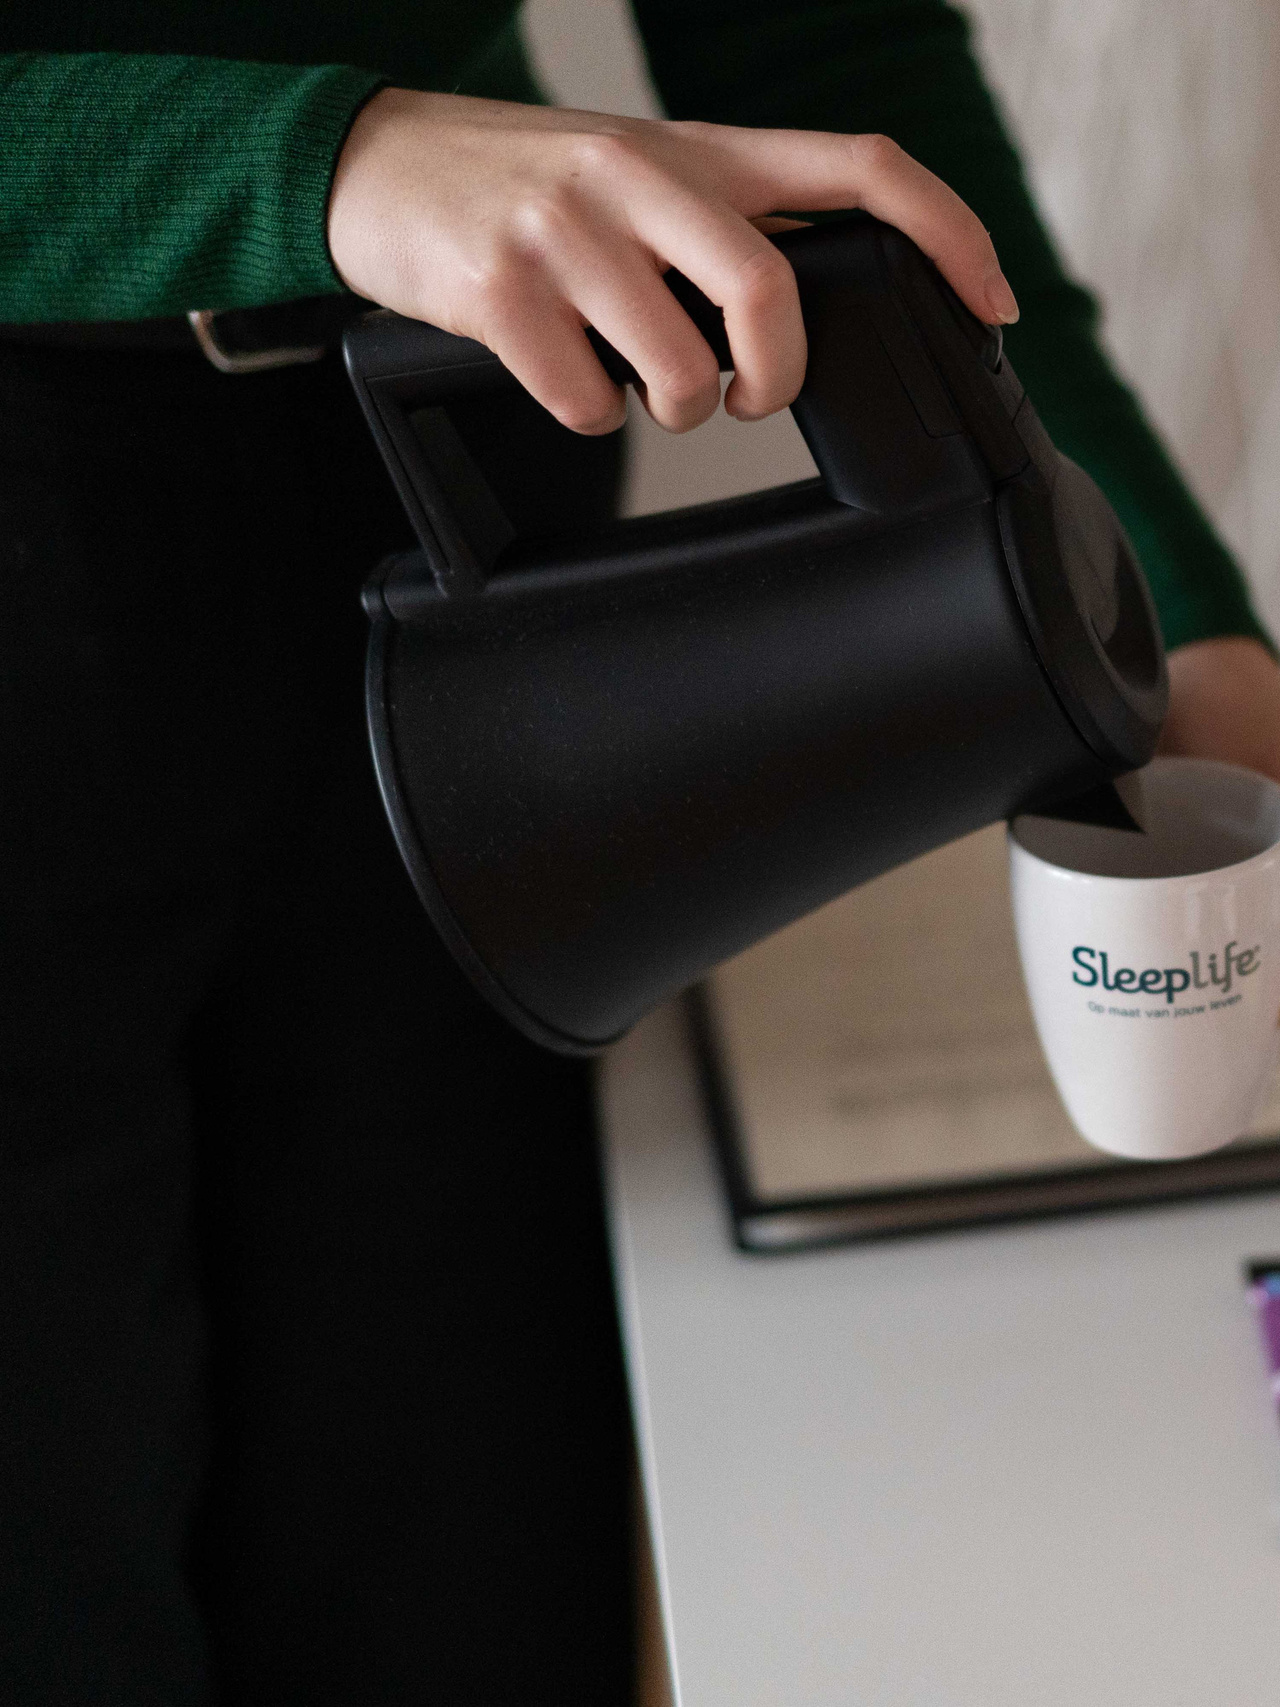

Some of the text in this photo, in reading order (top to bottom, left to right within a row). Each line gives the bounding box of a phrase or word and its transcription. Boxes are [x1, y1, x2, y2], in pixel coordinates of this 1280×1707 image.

[1072, 940, 1261, 1004] Sleeplife
[1109, 1005, 1141, 1018] maat
[1145, 1008, 1170, 1018] van
[1173, 1004, 1206, 1018] jouw
